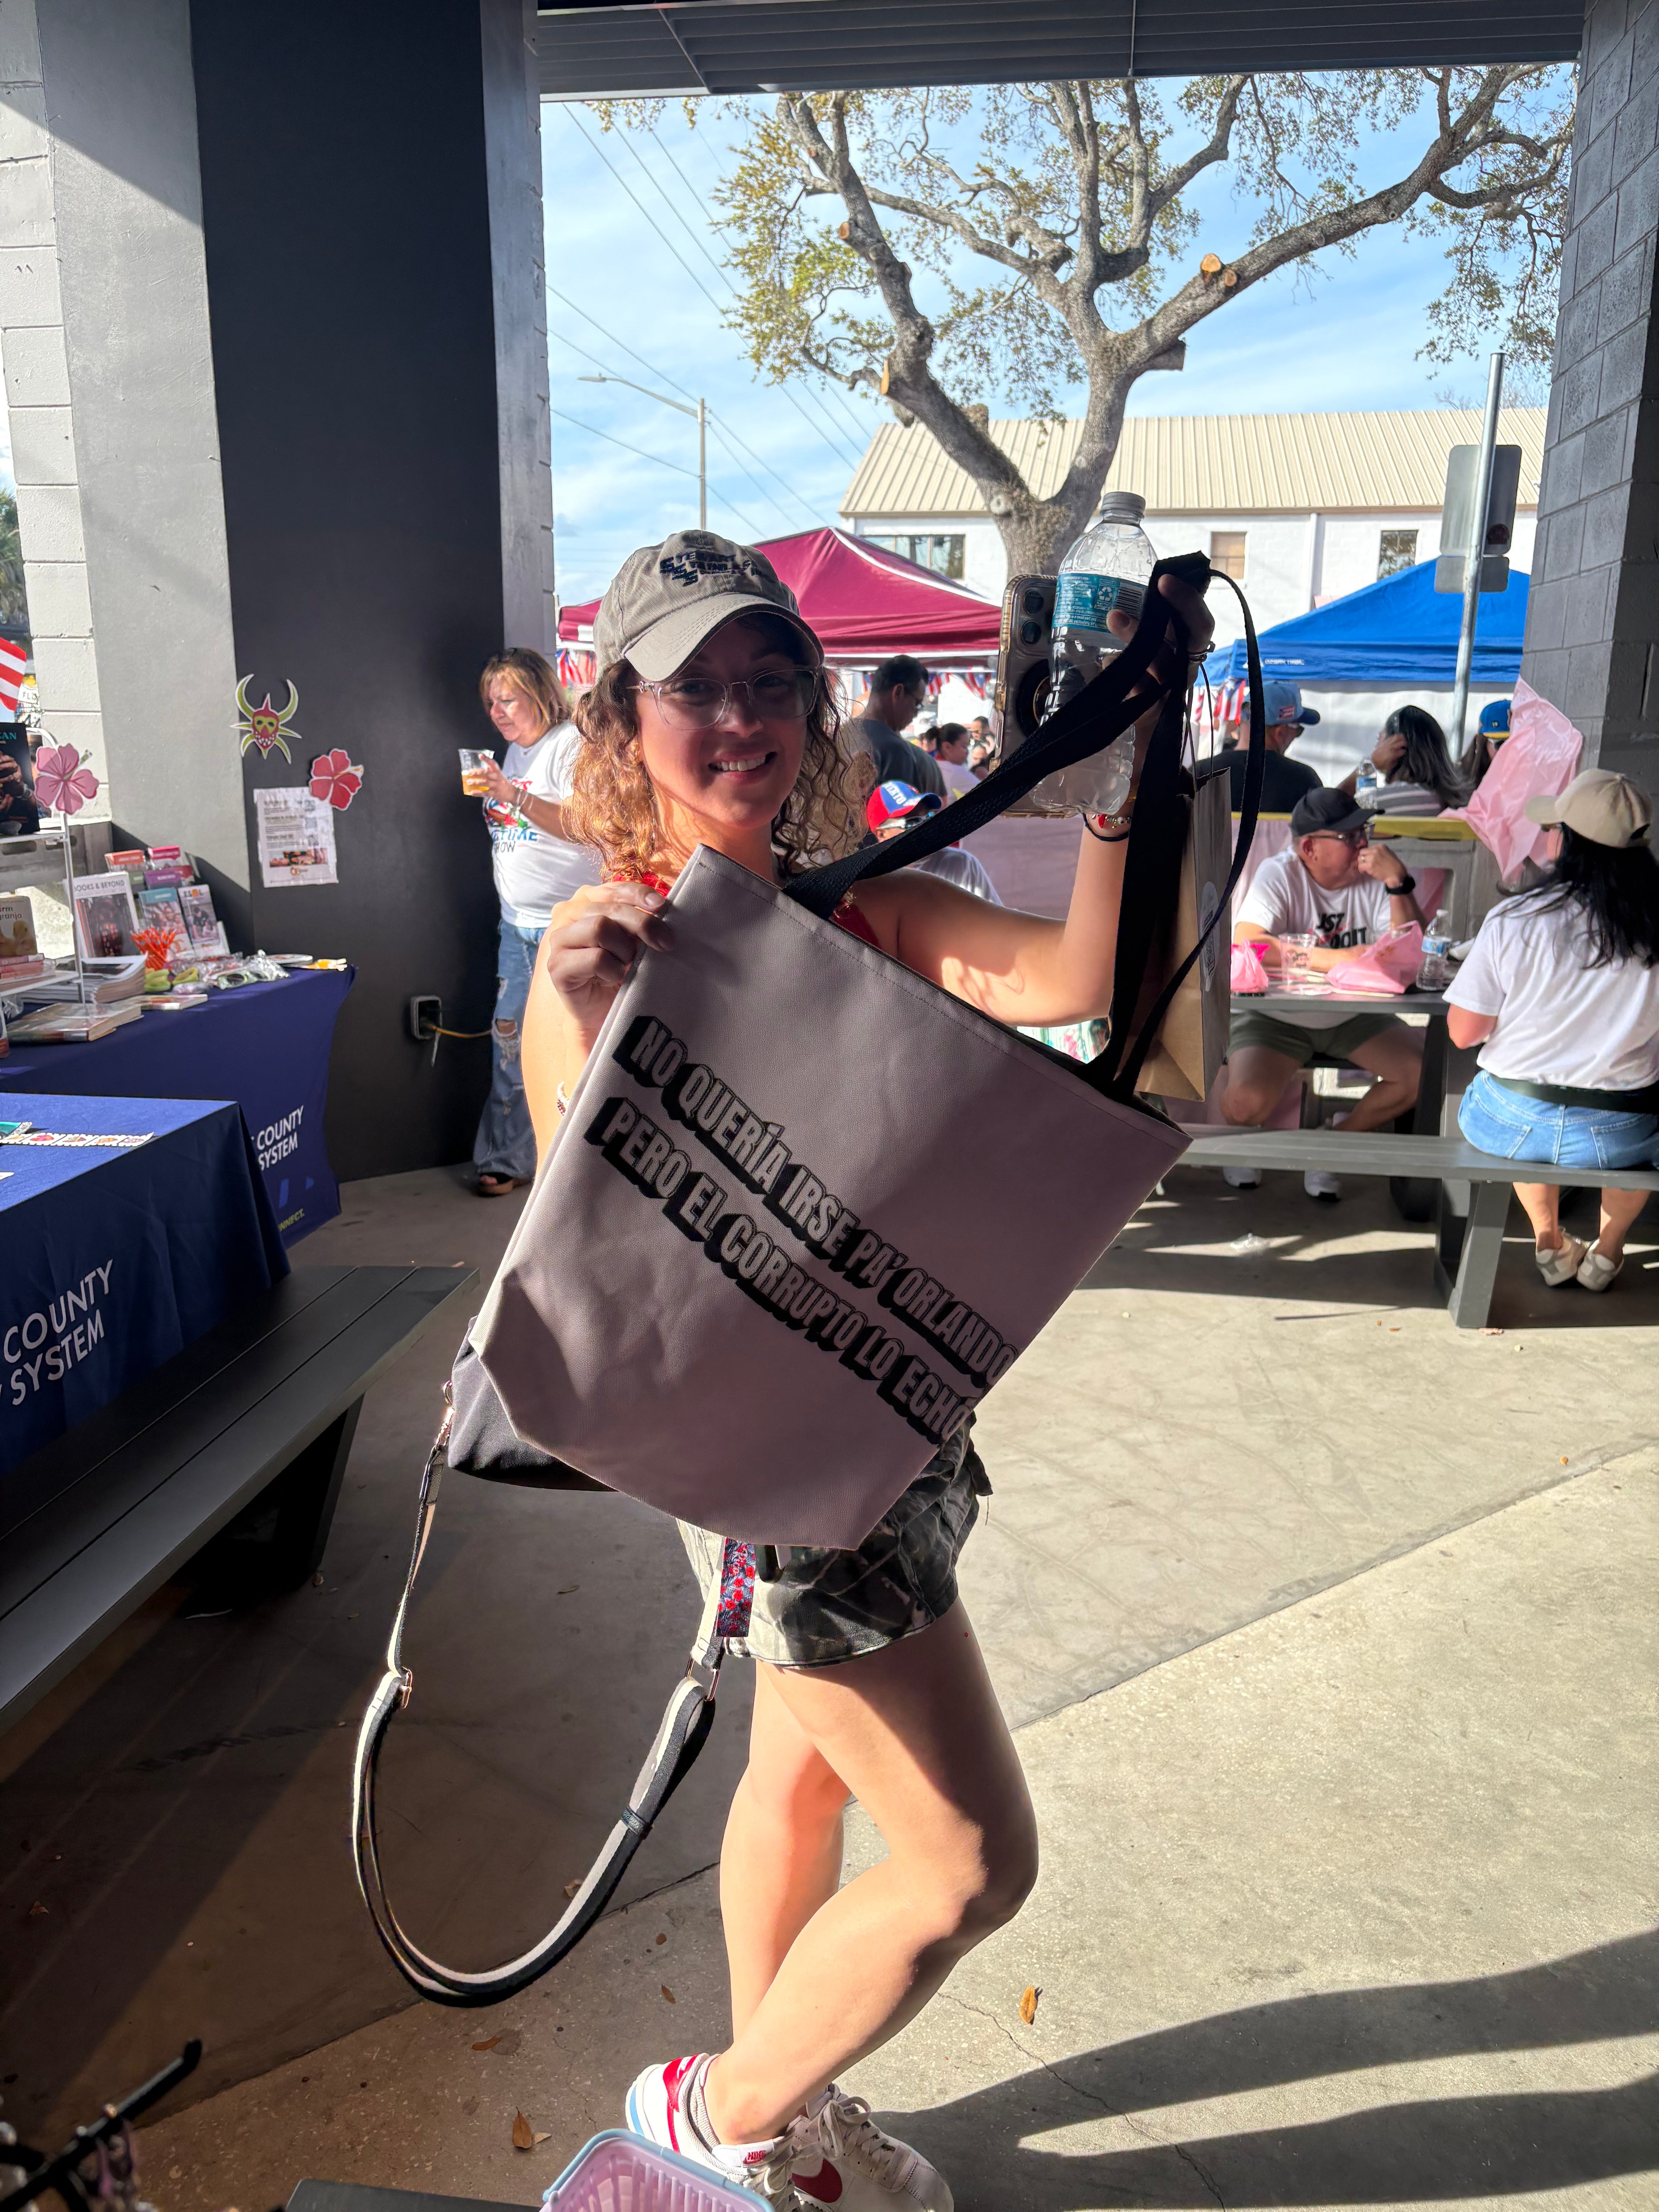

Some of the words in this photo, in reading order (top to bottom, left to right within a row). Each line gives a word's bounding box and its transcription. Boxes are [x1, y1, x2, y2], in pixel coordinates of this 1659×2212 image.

[101, 880, 124, 889] BEYOND
[257, 1105, 304, 1150] COUNTY
[258, 1131, 298, 1171] SYSTEM
[584, 1097, 691, 1199] PERO
[662, 1172, 728, 1242] EL
[704, 1214, 868, 1351] CORRUPTO
[838, 1326, 904, 1380] LO
[613, 1016, 688, 1088] NO
[661, 1063, 791, 1195] QUERÍA
[762, 1164, 861, 1259] IRSE
[877, 1268, 1019, 1388] ORLANDO
[4, 1259, 113, 1363] COUNTY
[11, 1309, 105, 1405] SYSTEM
